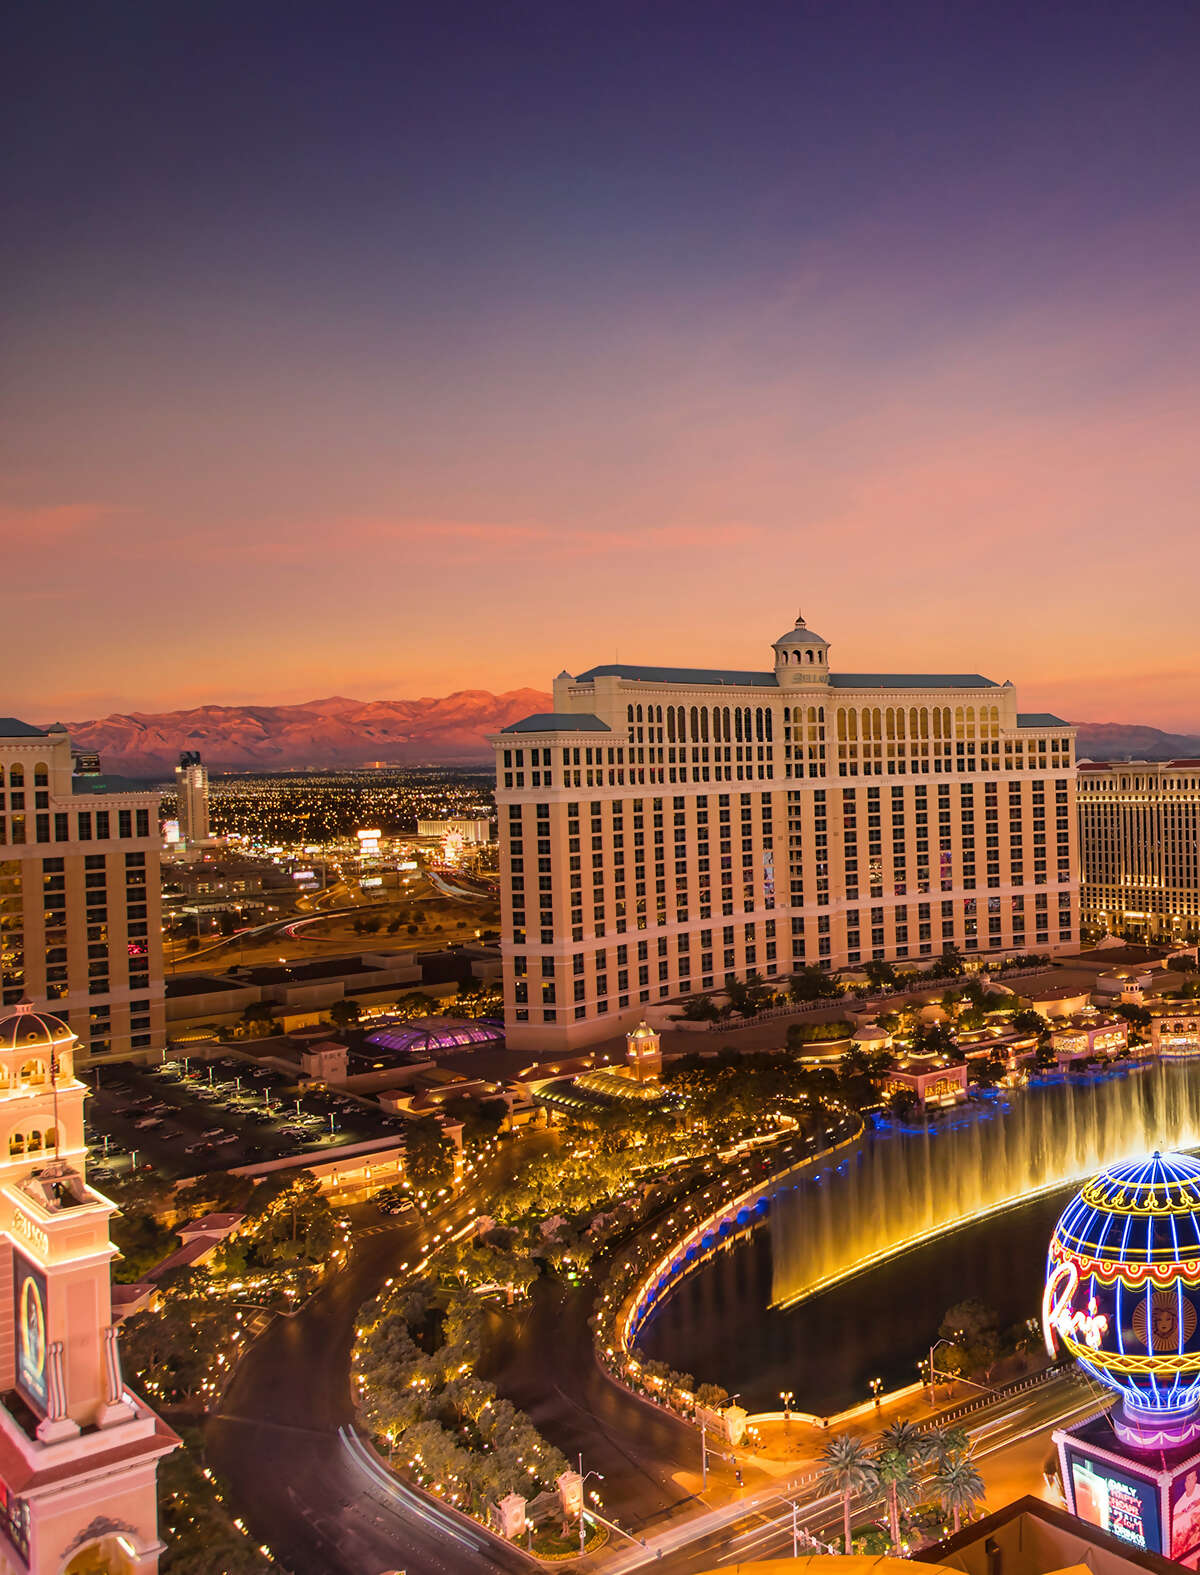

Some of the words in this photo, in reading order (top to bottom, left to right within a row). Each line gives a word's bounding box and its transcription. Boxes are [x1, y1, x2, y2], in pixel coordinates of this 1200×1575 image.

[1042, 1261, 1108, 1360] Paris
[1108, 1478, 1137, 1497] DAILY
[1109, 1489, 1143, 1507] HAPPY
[1110, 1497, 1140, 1516] HOUR
[1113, 1525, 1146, 1548] DRINKS
